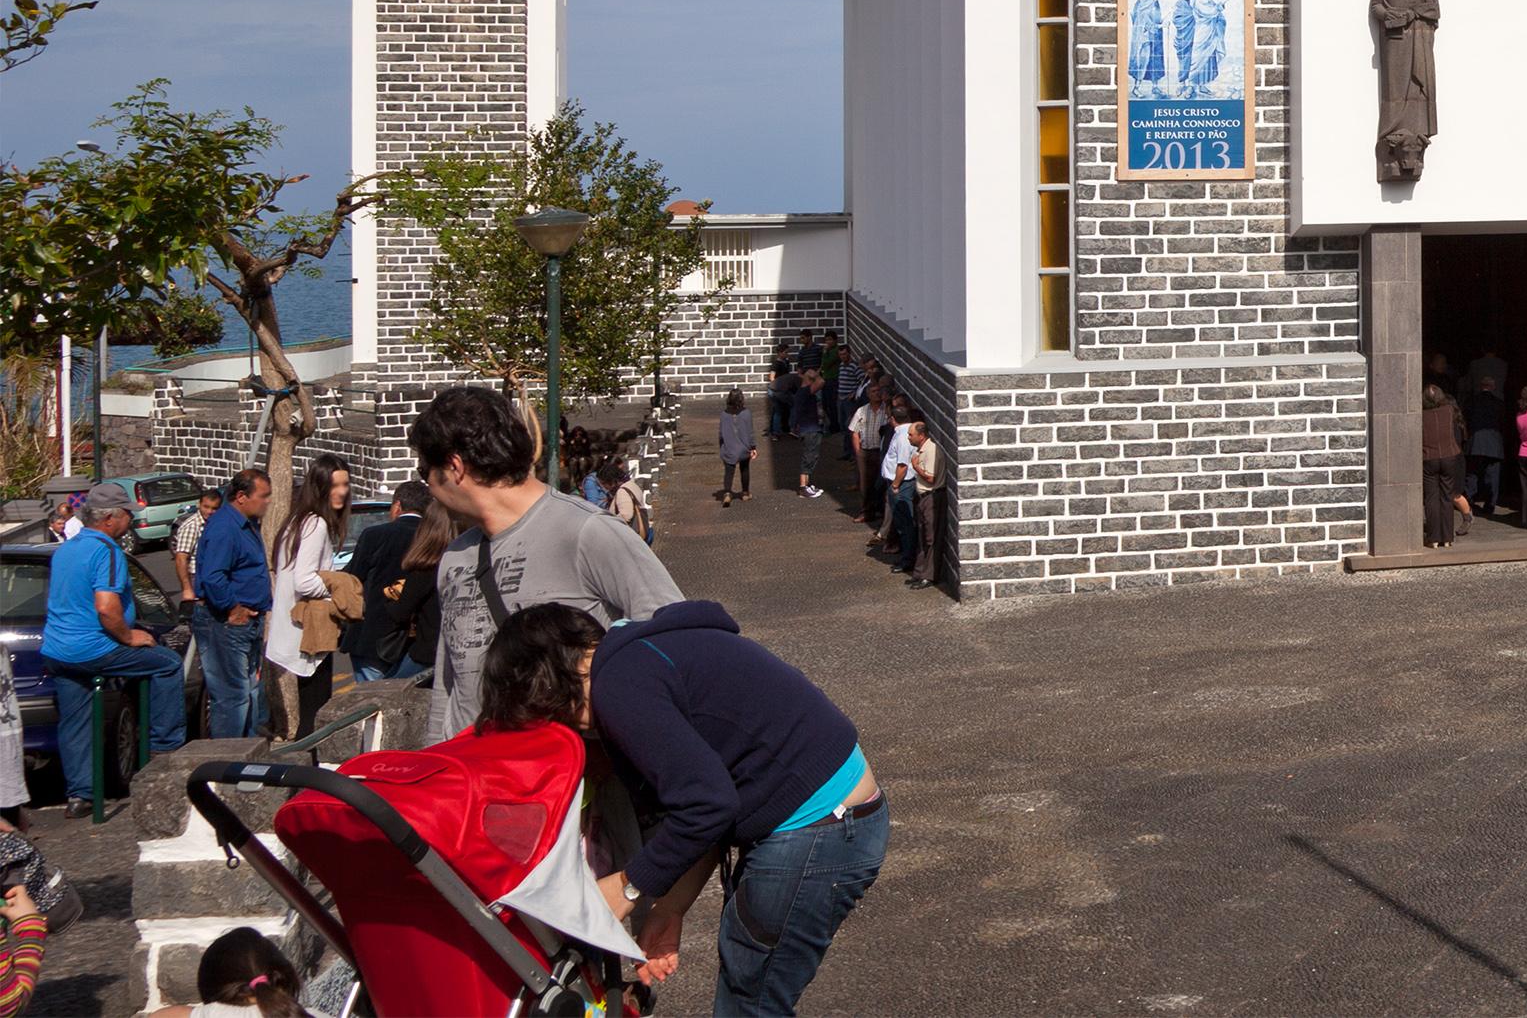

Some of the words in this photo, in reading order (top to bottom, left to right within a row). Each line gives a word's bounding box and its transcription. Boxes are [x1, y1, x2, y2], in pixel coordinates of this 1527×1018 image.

[1153, 108, 1181, 118] JESUS
[1183, 108, 1220, 116] CRISTO
[1132, 119, 1181, 128] CAMINHA
[1183, 119, 1241, 128] CONNOSCO
[1146, 131, 1152, 139] E
[1154, 131, 1195, 139] REPARTE
[1197, 131, 1206, 139] O
[1208, 129, 1228, 139] PÃO
[1142, 141, 1231, 169] 2013
